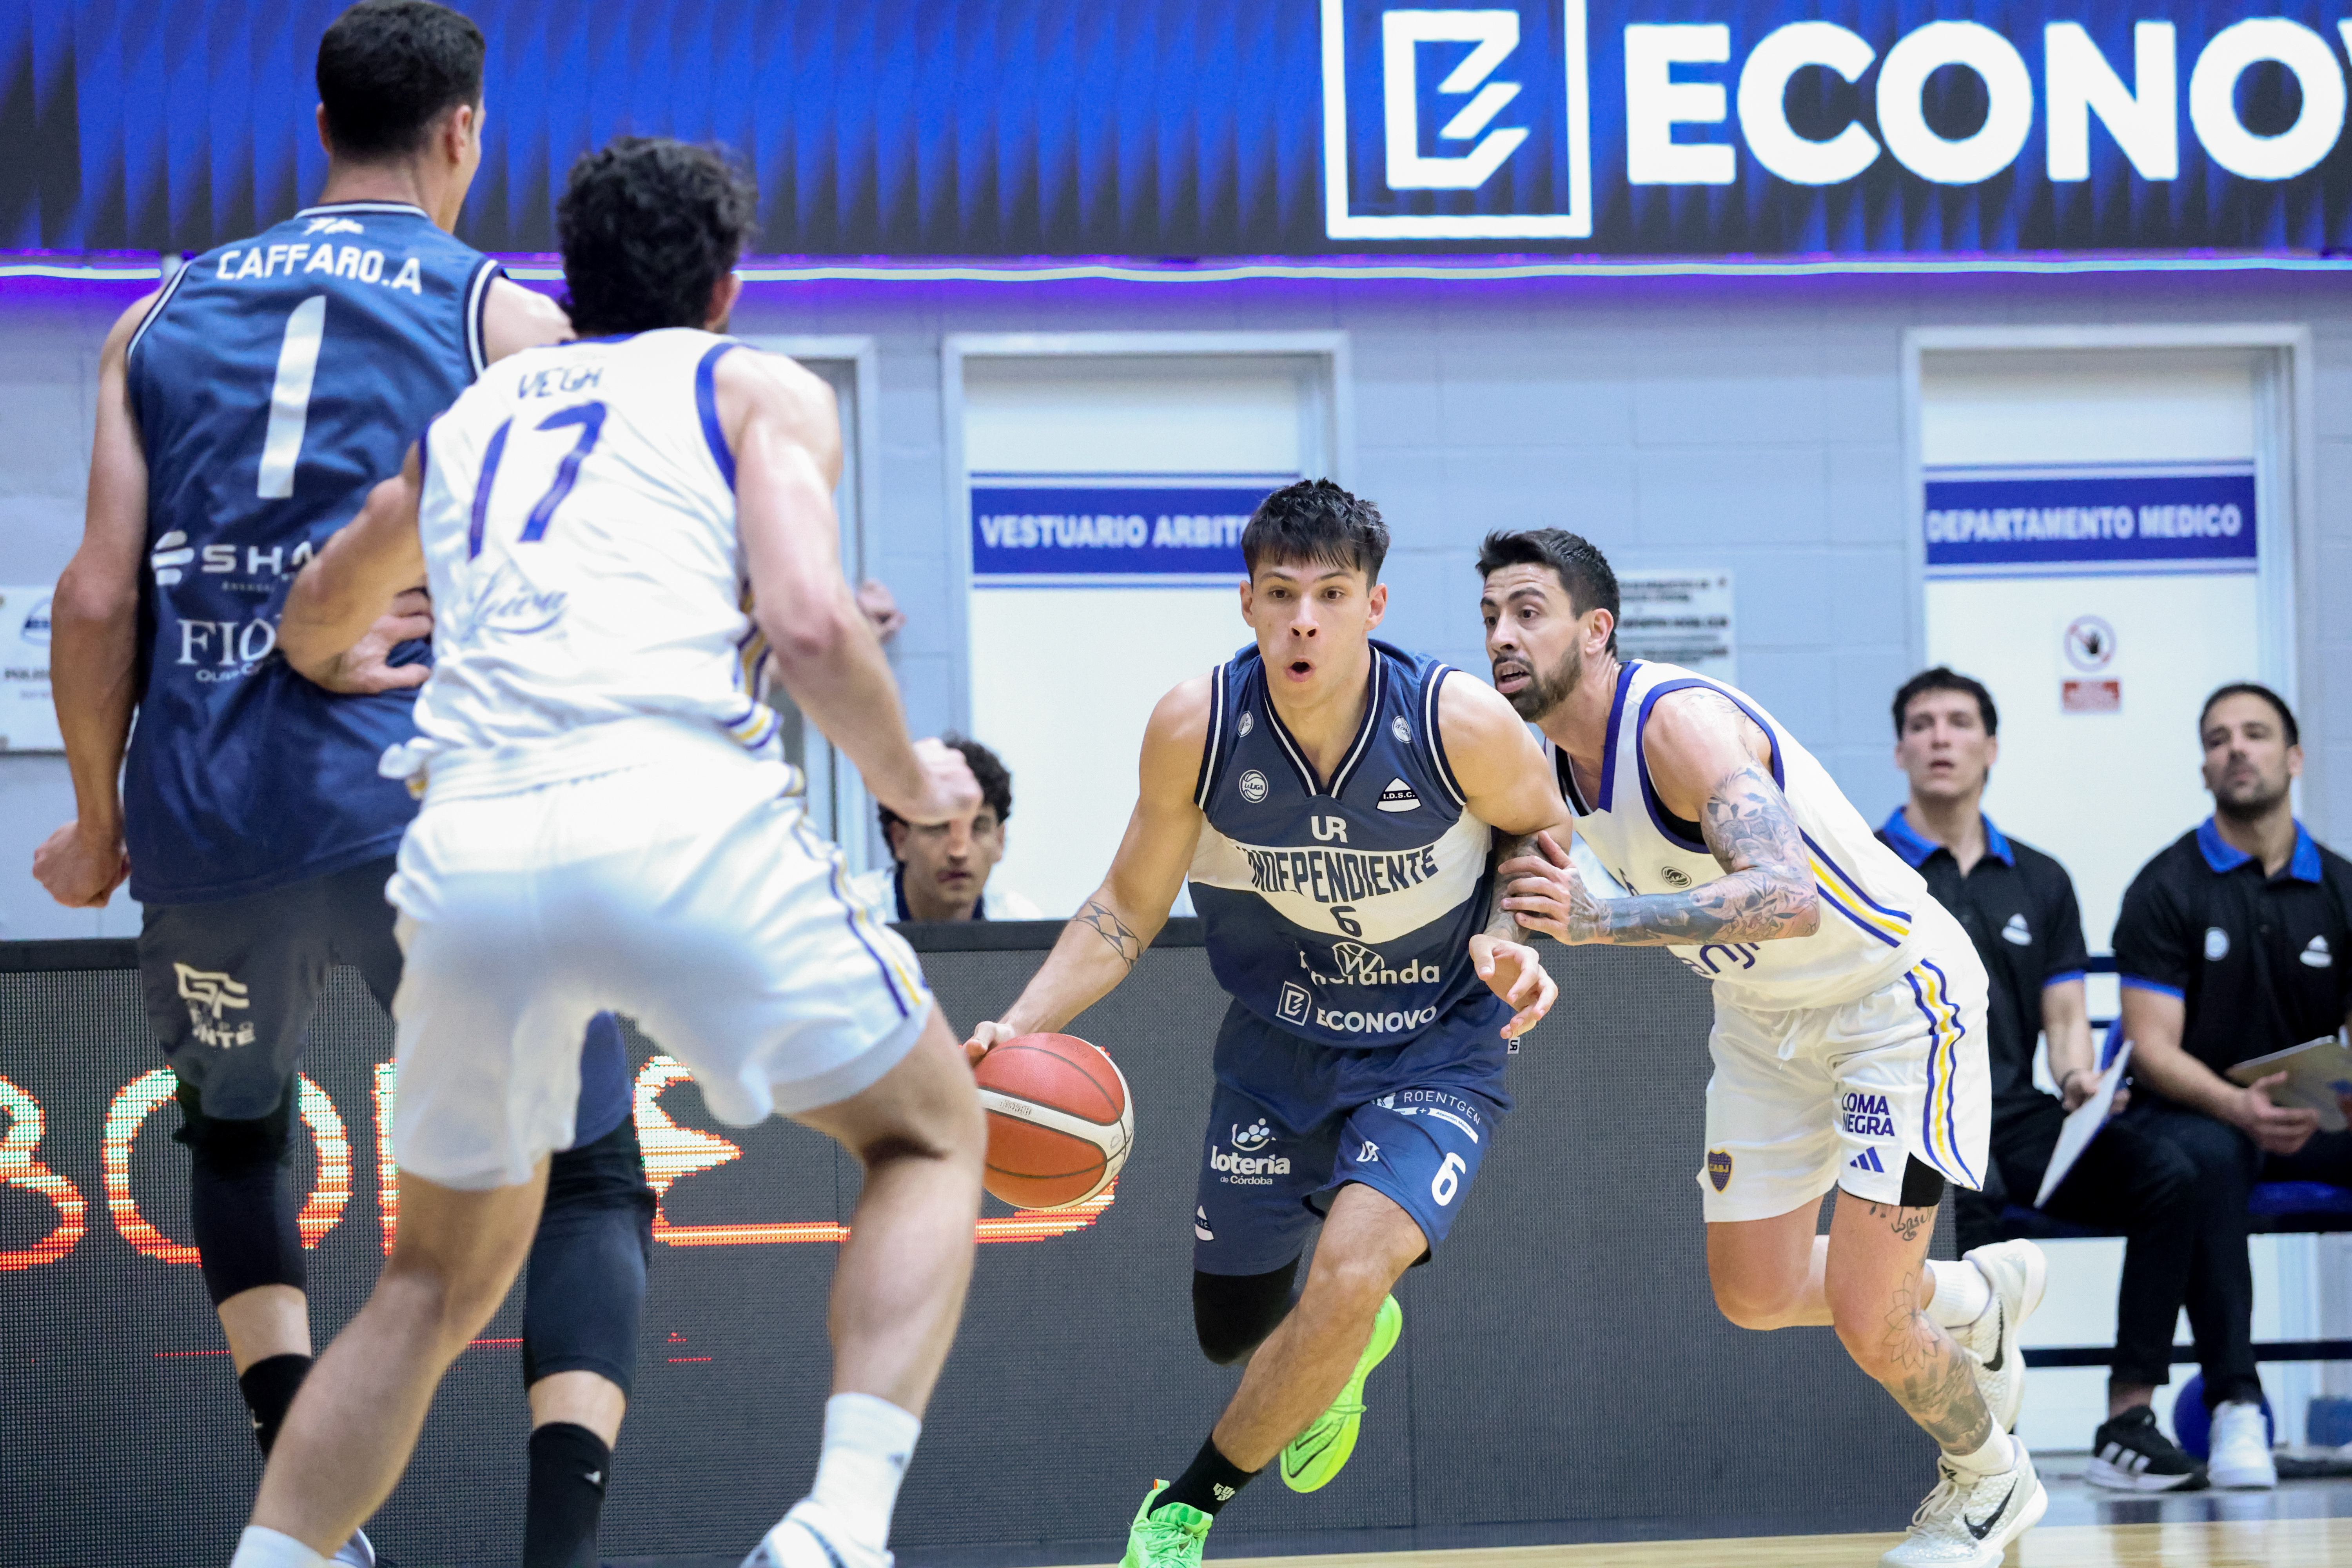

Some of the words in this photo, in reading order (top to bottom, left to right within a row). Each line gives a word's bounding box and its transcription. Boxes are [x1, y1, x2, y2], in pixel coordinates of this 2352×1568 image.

[1625, 17, 2352, 185] ECONO
[216, 244, 422, 295] CAFFARO.A
[257, 294, 327, 498] 1
[468, 400, 607, 564] 17
[979, 514, 1148, 549] VESTUARIO
[1926, 506, 2135, 544] DEPARTAMENTO
[2138, 503, 2243, 539] MEDICO
[1311, 816, 1348, 843] UR
[1330, 906, 1362, 937] 6
[1316, 1005, 1437, 1033] ECONOVO
[1404, 1091, 1481, 1125] ROENTGEN
[1842, 1112, 1895, 1136] NEGRA
[1230, 1176, 1273, 1185] Córdoba
[1432, 1152, 1466, 1206] 6
